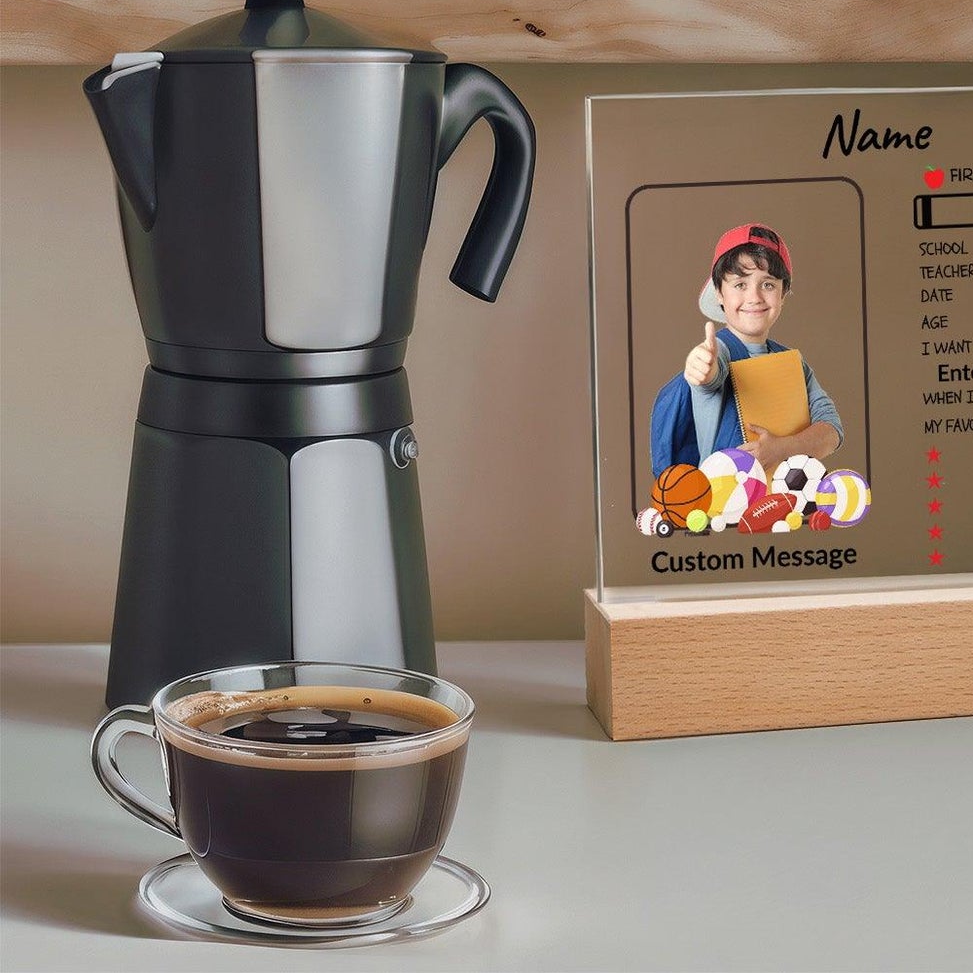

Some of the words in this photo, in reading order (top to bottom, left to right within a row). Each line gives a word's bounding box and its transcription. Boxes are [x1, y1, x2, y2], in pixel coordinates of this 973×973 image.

[823, 109, 932, 159] Name
[919, 241, 968, 256] SCHOOL
[921, 288, 953, 302] DATE
[922, 315, 948, 329] AGE
[922, 342, 929, 355] I
[934, 339, 972, 354] WANT
[923, 390, 962, 404] WHEN
[967, 390, 973, 404] I
[925, 419, 942, 433] MY
[652, 551, 743, 573] Custom
[753, 546, 856, 570] Message
